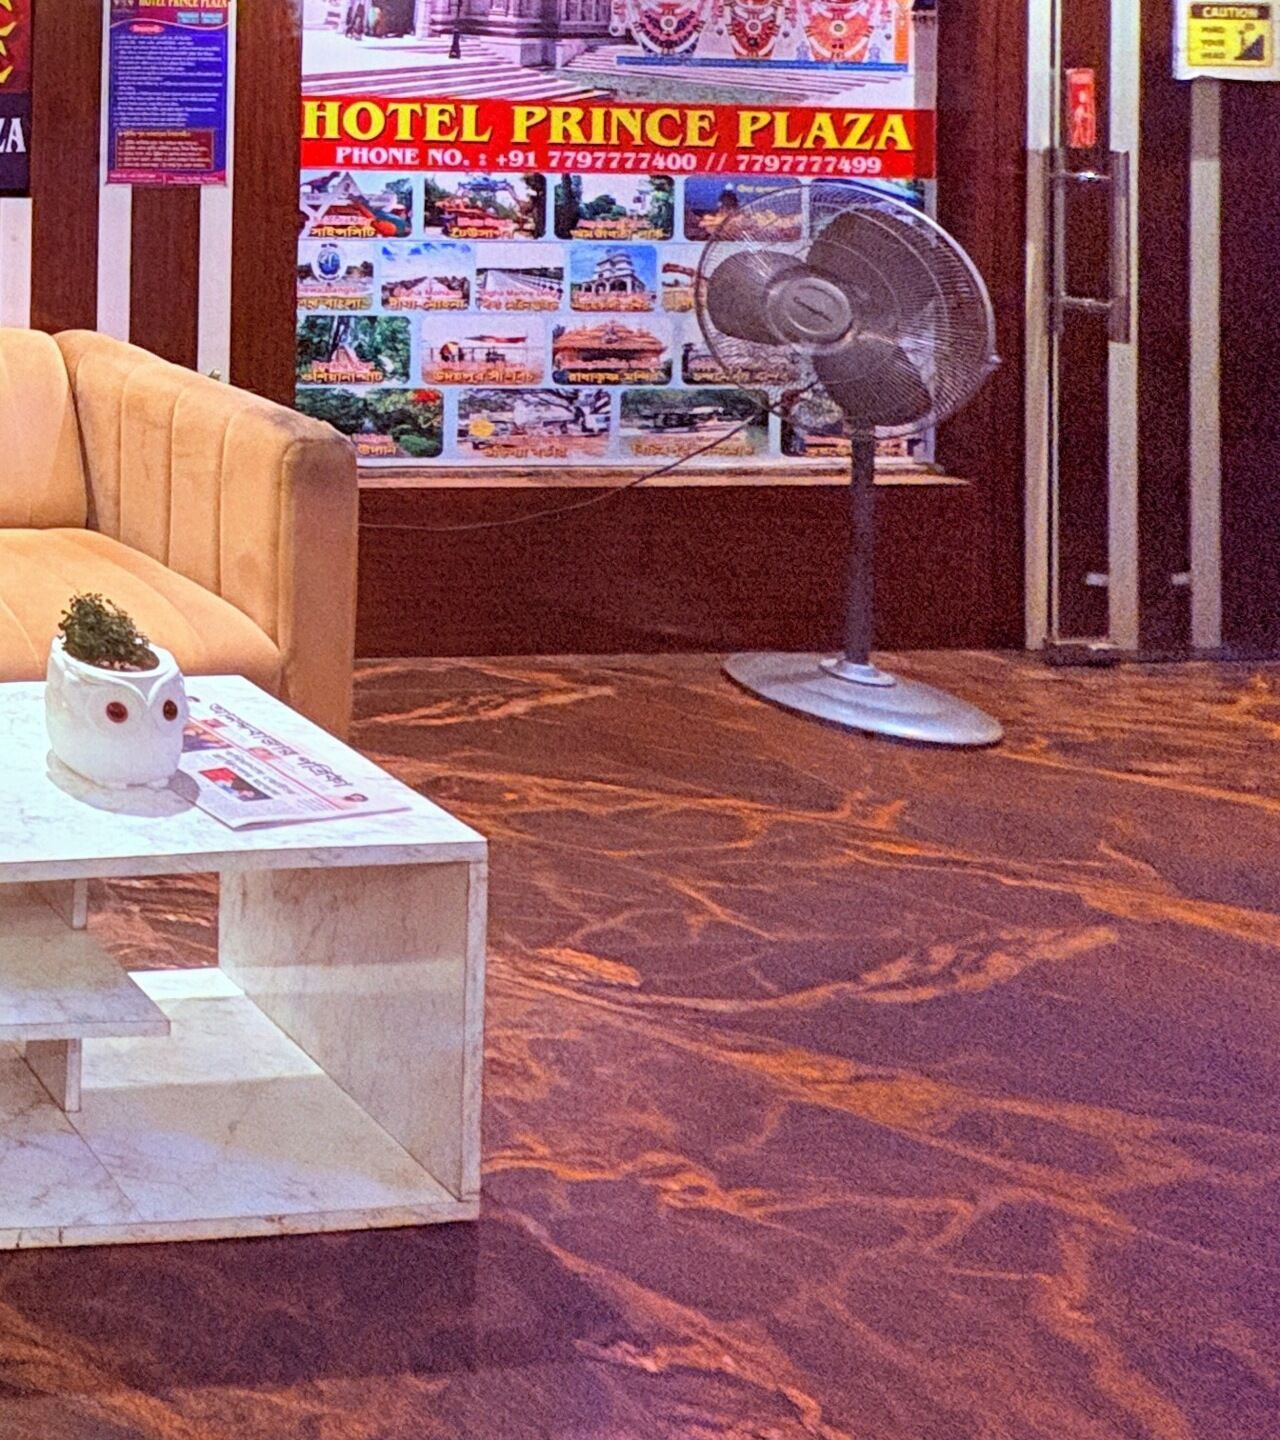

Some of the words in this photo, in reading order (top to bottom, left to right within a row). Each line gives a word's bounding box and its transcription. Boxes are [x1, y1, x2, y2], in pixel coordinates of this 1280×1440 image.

[1202, 6, 1259, 18] CAUTION
[301, 101, 492, 142] HOTEL
[511, 105, 719, 148] PRINCE
[736, 110, 913, 151] PLAZA
[335, 146, 420, 166] PHONE
[427, 148, 470, 167] NO.
[496, 150, 538, 168] +91
[548, 151, 697, 171] 7797777400
[738, 154, 881, 173] 7797777499
